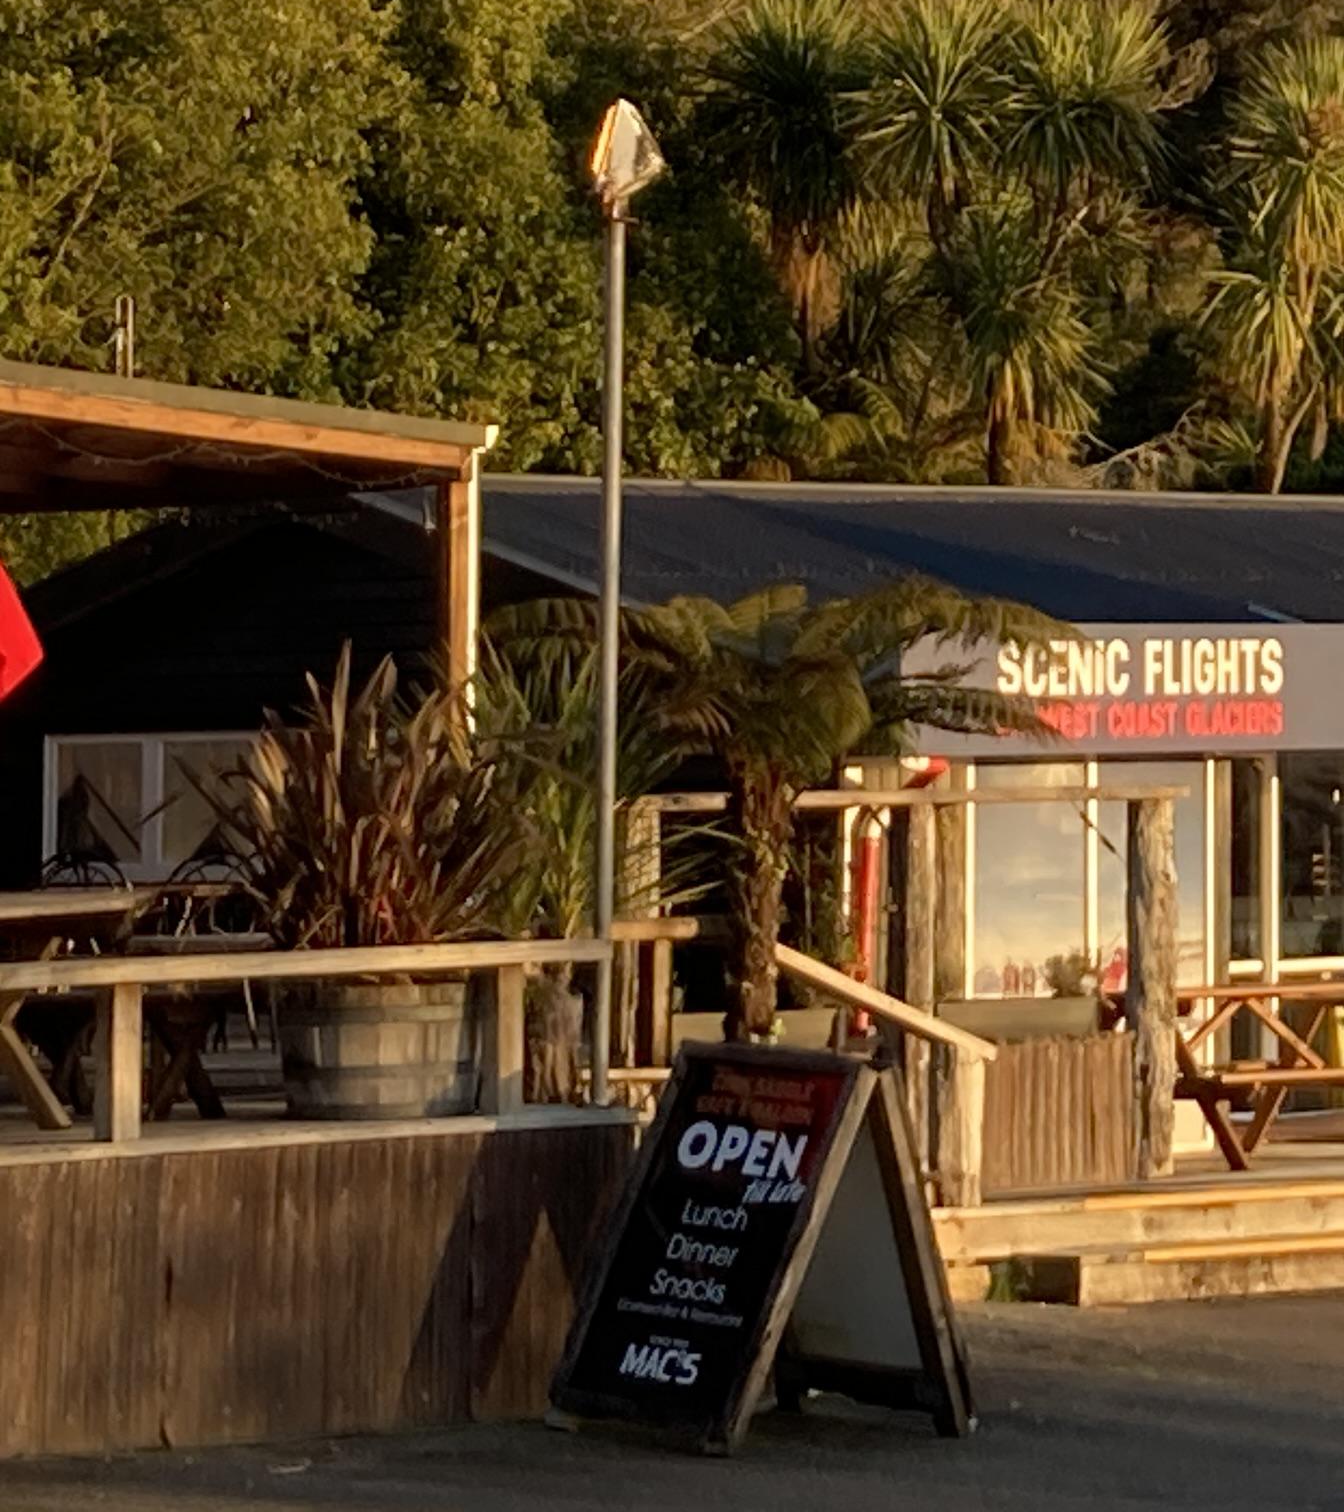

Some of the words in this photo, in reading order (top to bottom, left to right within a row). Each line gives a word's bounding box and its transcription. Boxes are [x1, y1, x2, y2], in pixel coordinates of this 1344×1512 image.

[997, 637, 1130, 697] SCENIC
[1145, 638, 1284, 696] FLIGHTS
[1107, 701, 1178, 740] COAST
[1185, 699, 1283, 737] GLACIERS
[677, 1120, 808, 1180] OPEN
[681, 1198, 748, 1231] Lunch
[666, 1233, 739, 1267] Dinner
[650, 1268, 726, 1304] Snacks
